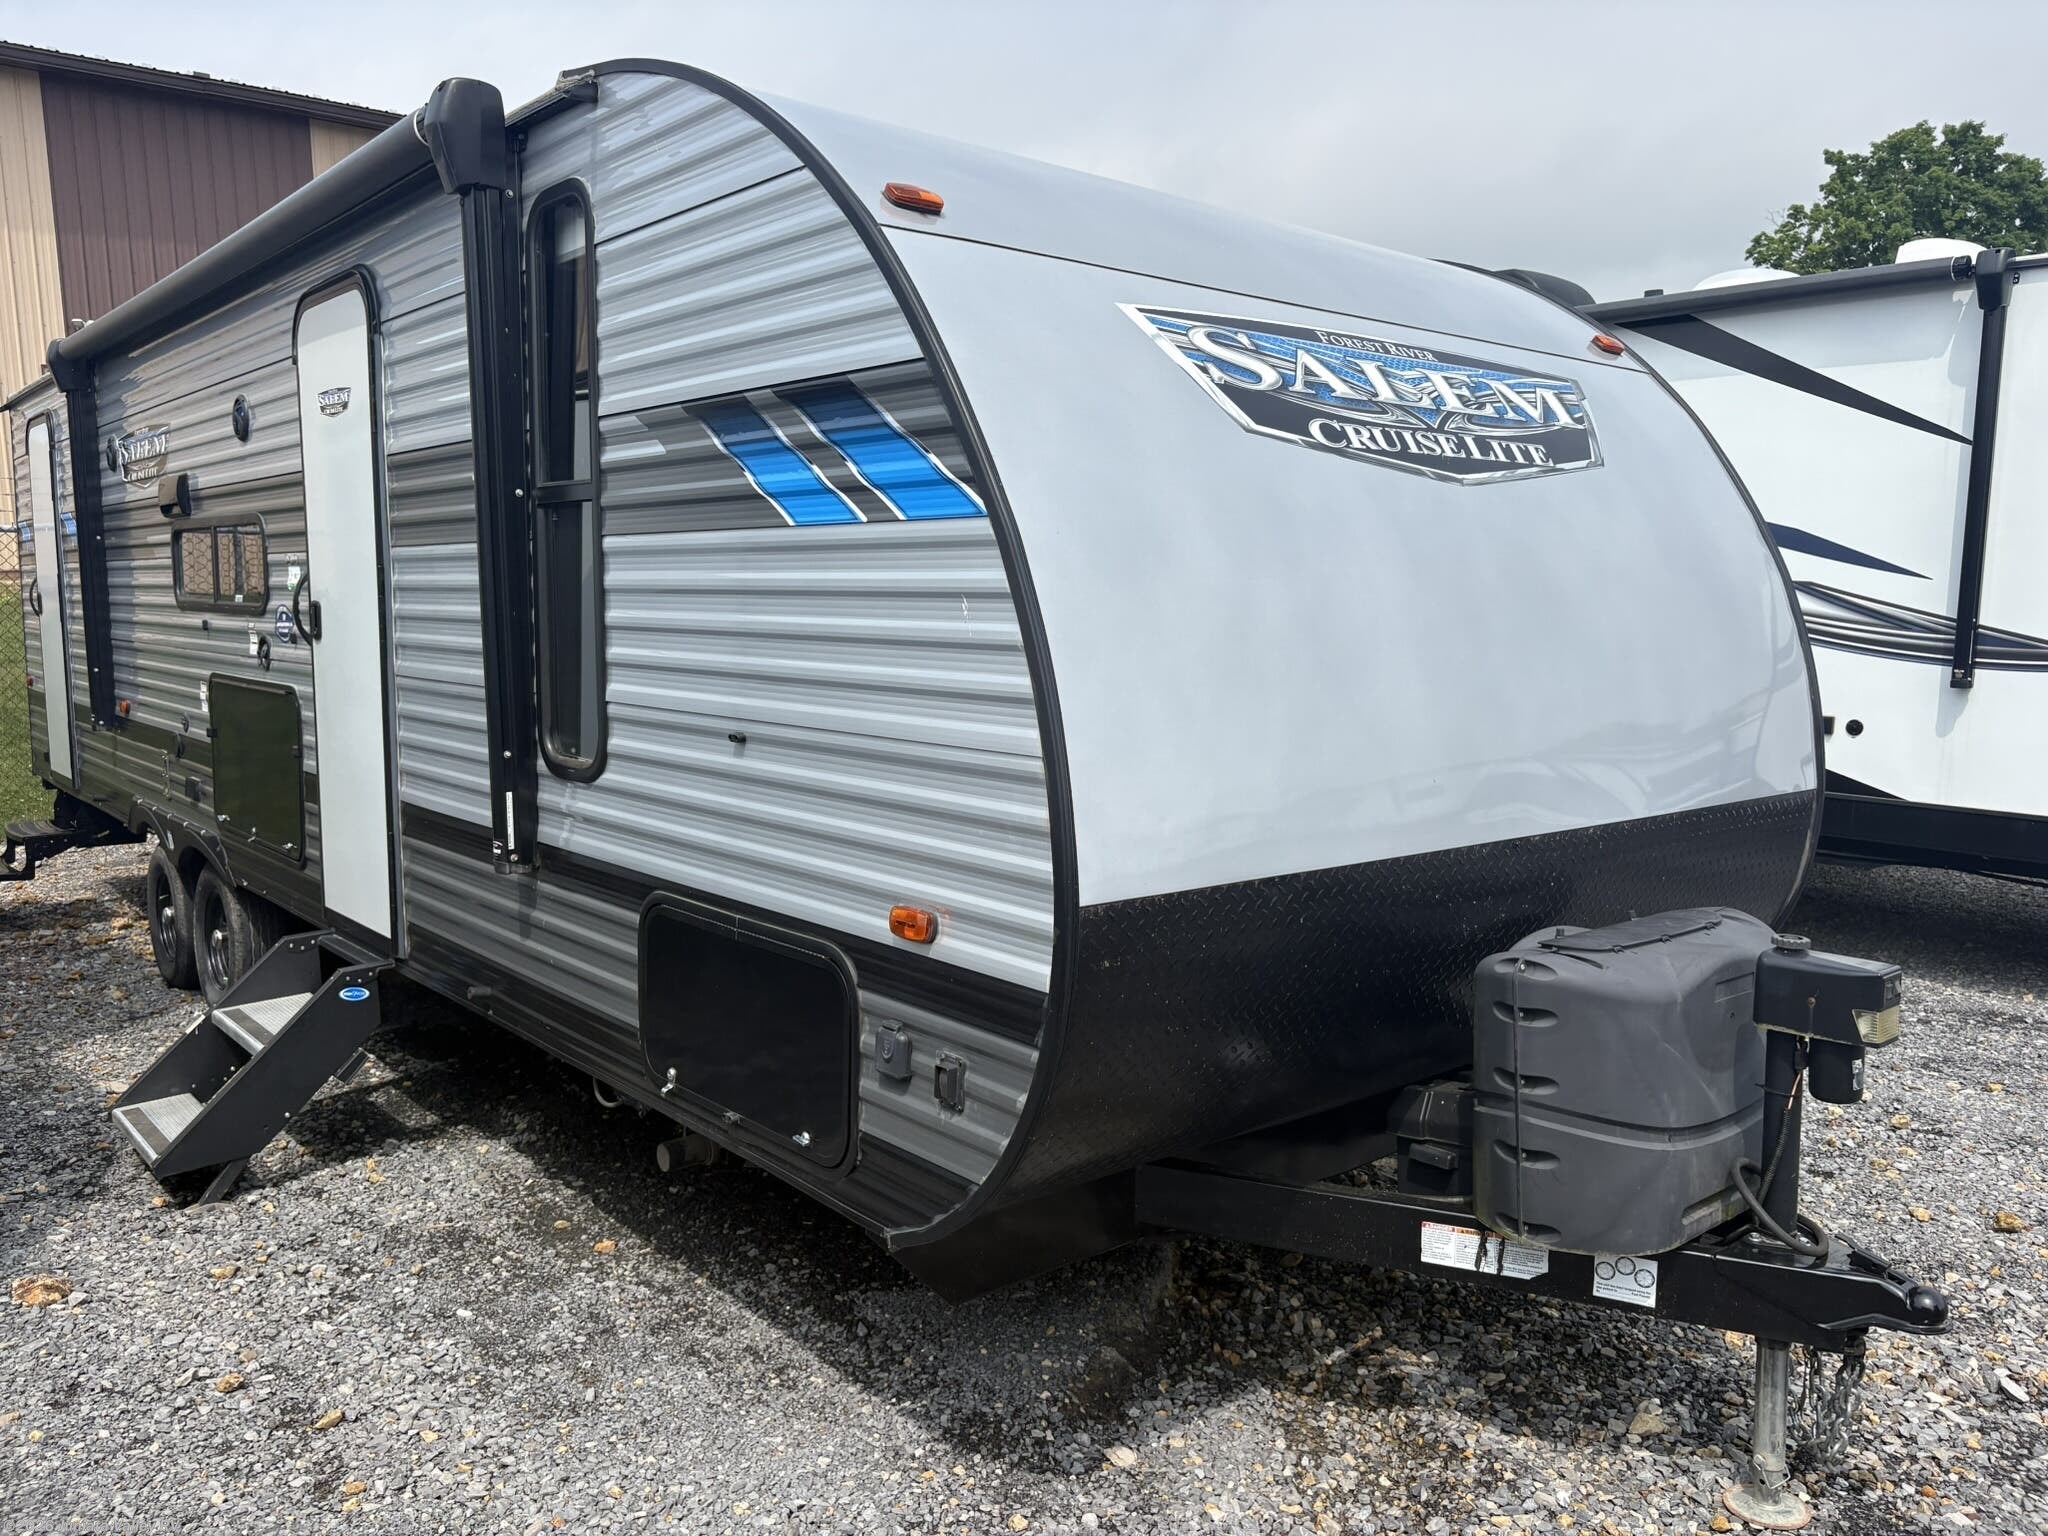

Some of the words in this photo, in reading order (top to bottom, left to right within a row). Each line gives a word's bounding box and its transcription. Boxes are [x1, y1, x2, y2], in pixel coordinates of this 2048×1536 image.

[1187, 325, 1587, 430] SALEM
[1315, 330, 1382, 353] FOREST
[1384, 342, 1438, 362] RIVER
